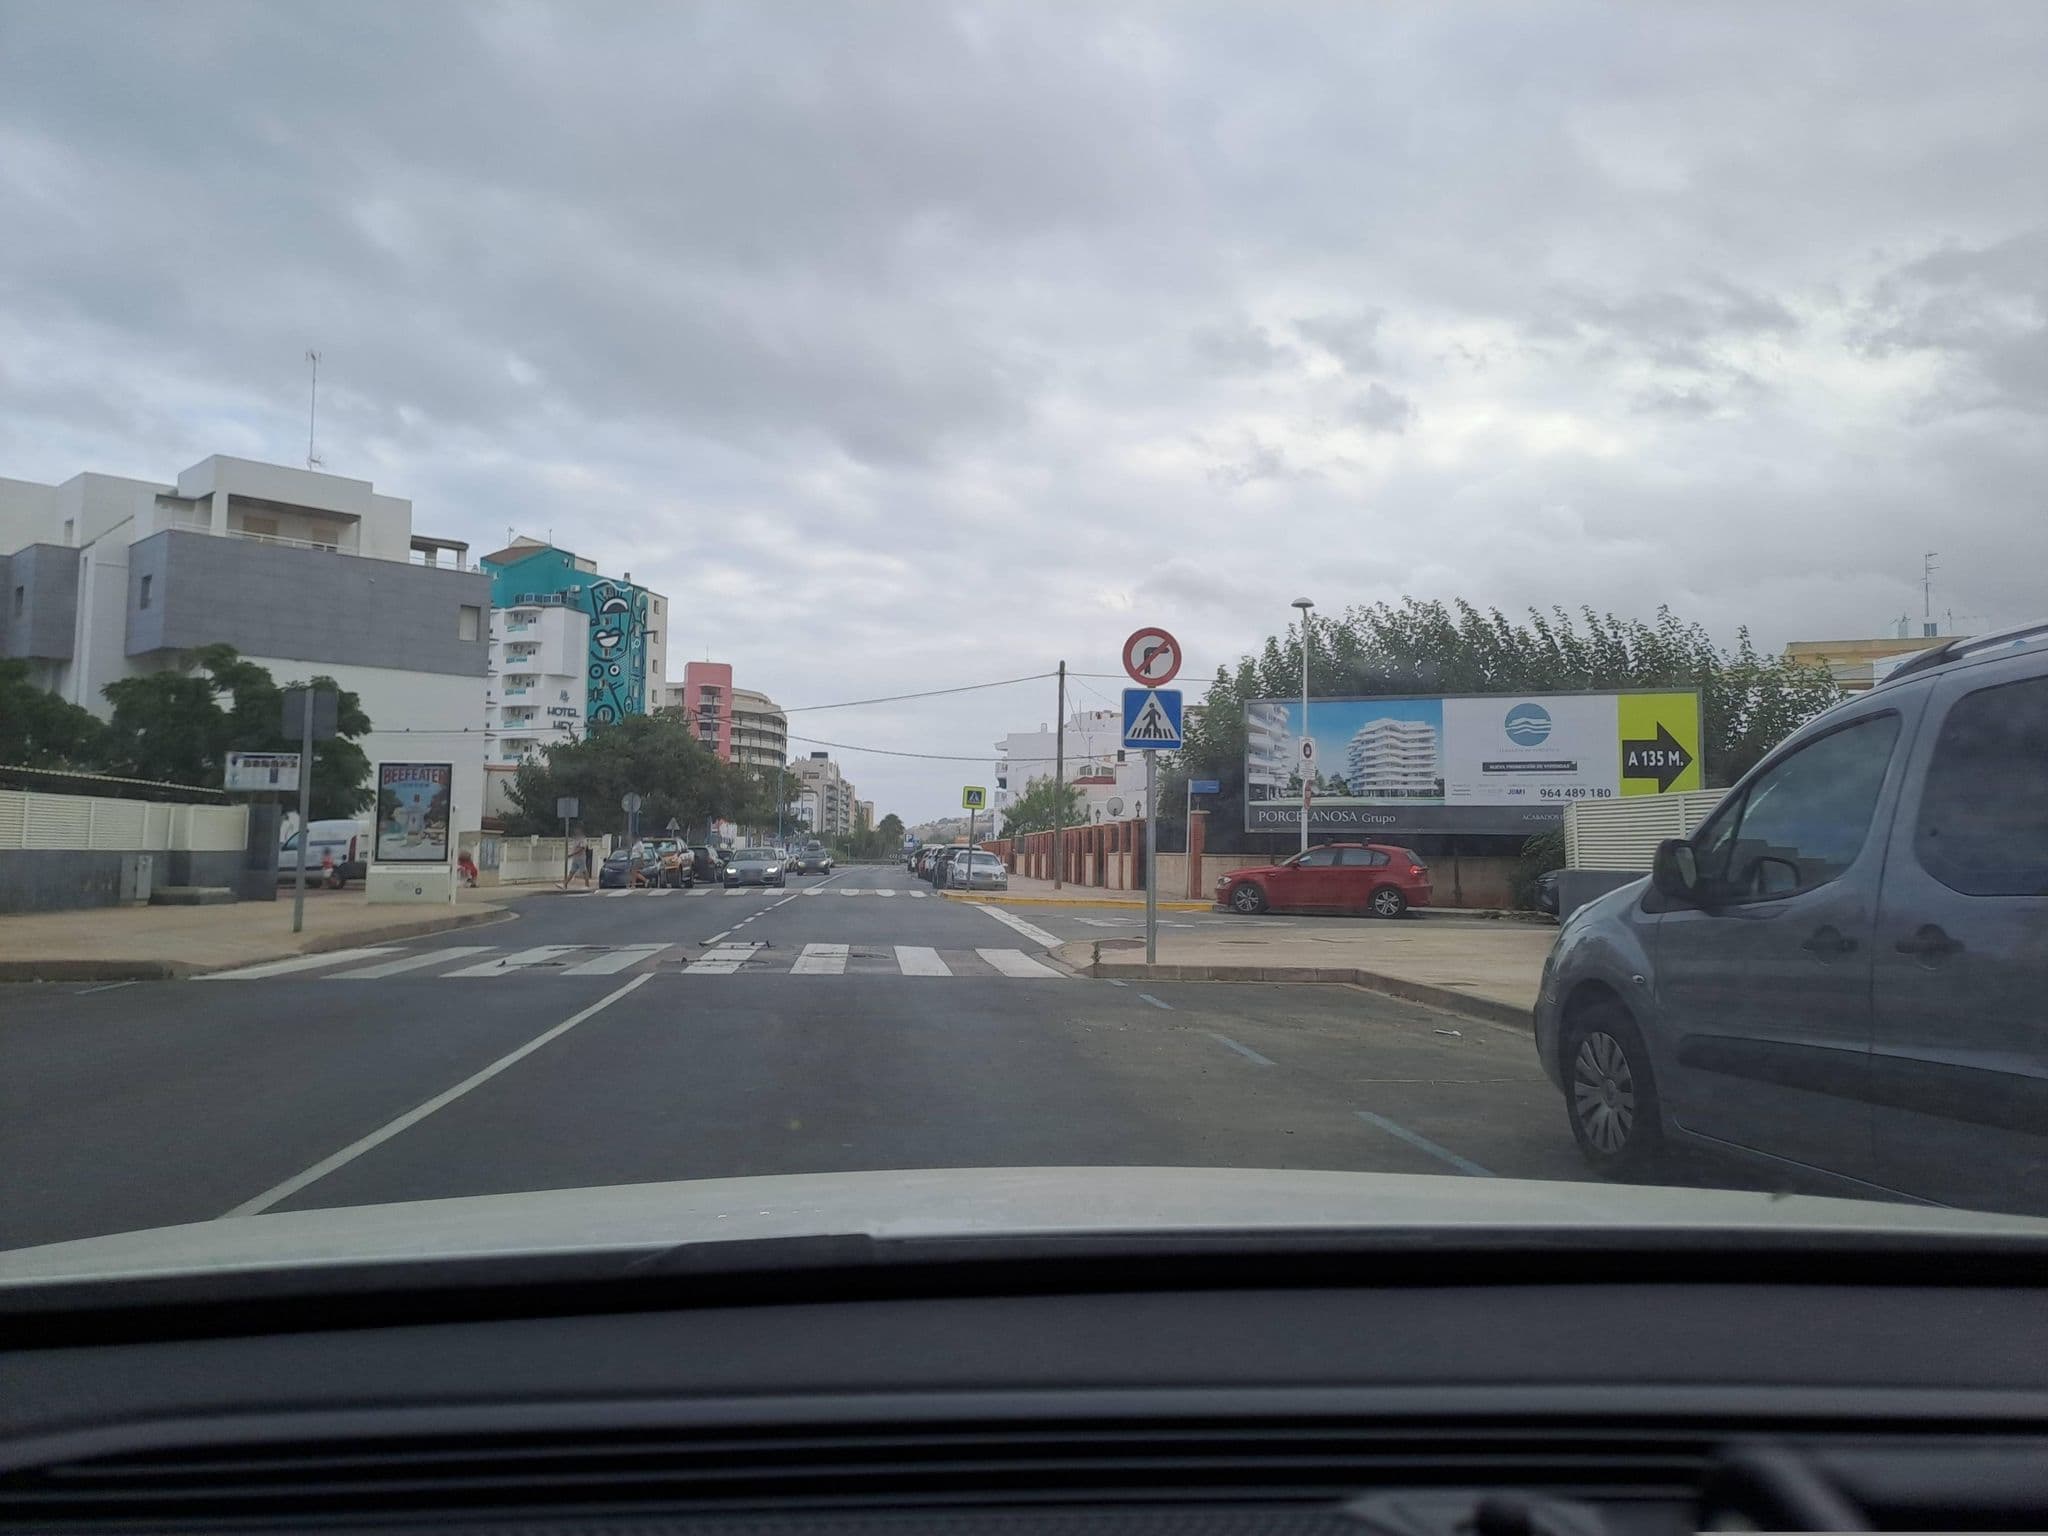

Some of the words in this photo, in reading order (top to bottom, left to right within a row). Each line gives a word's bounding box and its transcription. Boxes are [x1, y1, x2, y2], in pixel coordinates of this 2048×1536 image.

[547, 706, 580, 718] HOTEL
[1628, 751, 1639, 766] A
[1641, 751, 1664, 766] 135
[1668, 751, 1684, 766] M.
[383, 767, 449, 785] BEEFEATER
[1540, 788, 1561, 798] 964
[1565, 788, 1586, 798] 489
[1590, 788, 1611, 798] 180
[1361, 813, 1396, 825] Grupo
